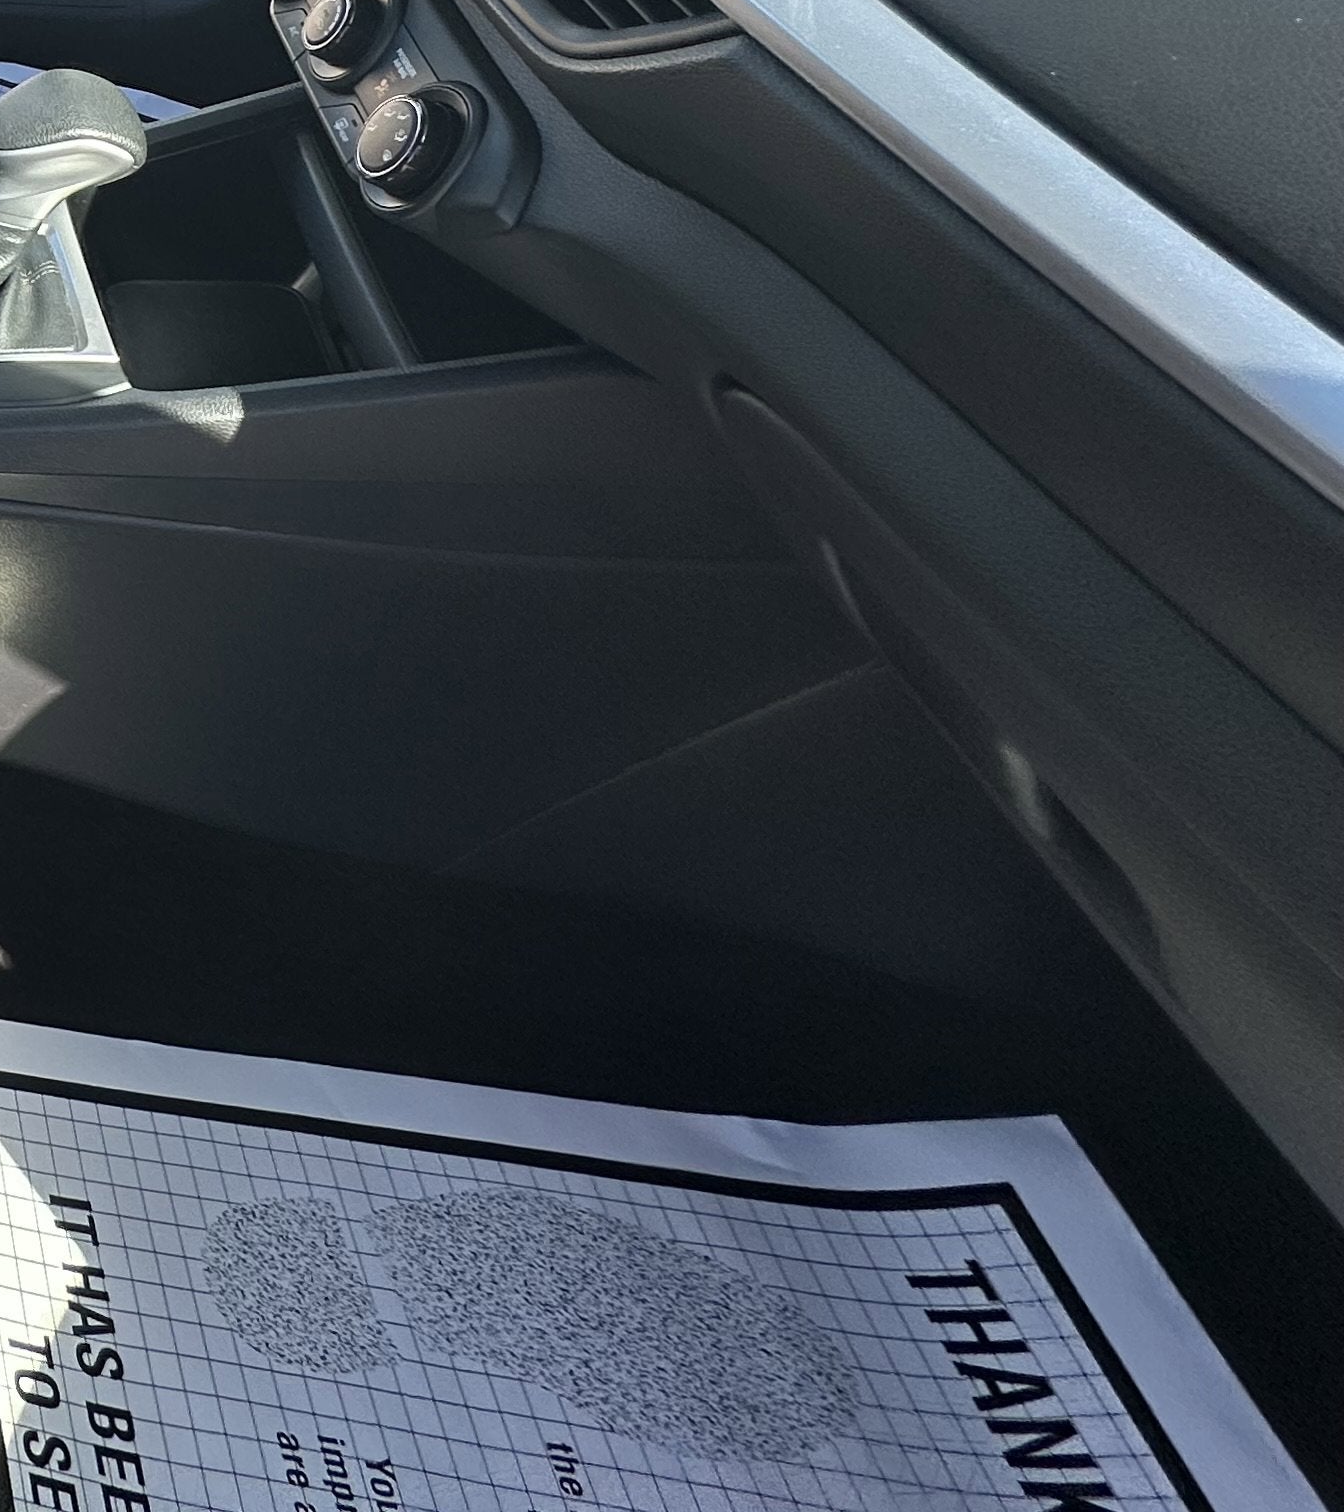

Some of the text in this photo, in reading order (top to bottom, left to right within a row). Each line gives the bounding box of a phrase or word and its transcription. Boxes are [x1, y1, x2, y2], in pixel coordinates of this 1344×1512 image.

[49, 1193, 100, 1248] IT
[61, 1261, 124, 1381] HAS
[7, 1335, 61, 1410] TO
[905, 1258, 1118, 1512] THANK
[276, 1431, 310, 1488] are
[546, 1442, 585, 1498] the
